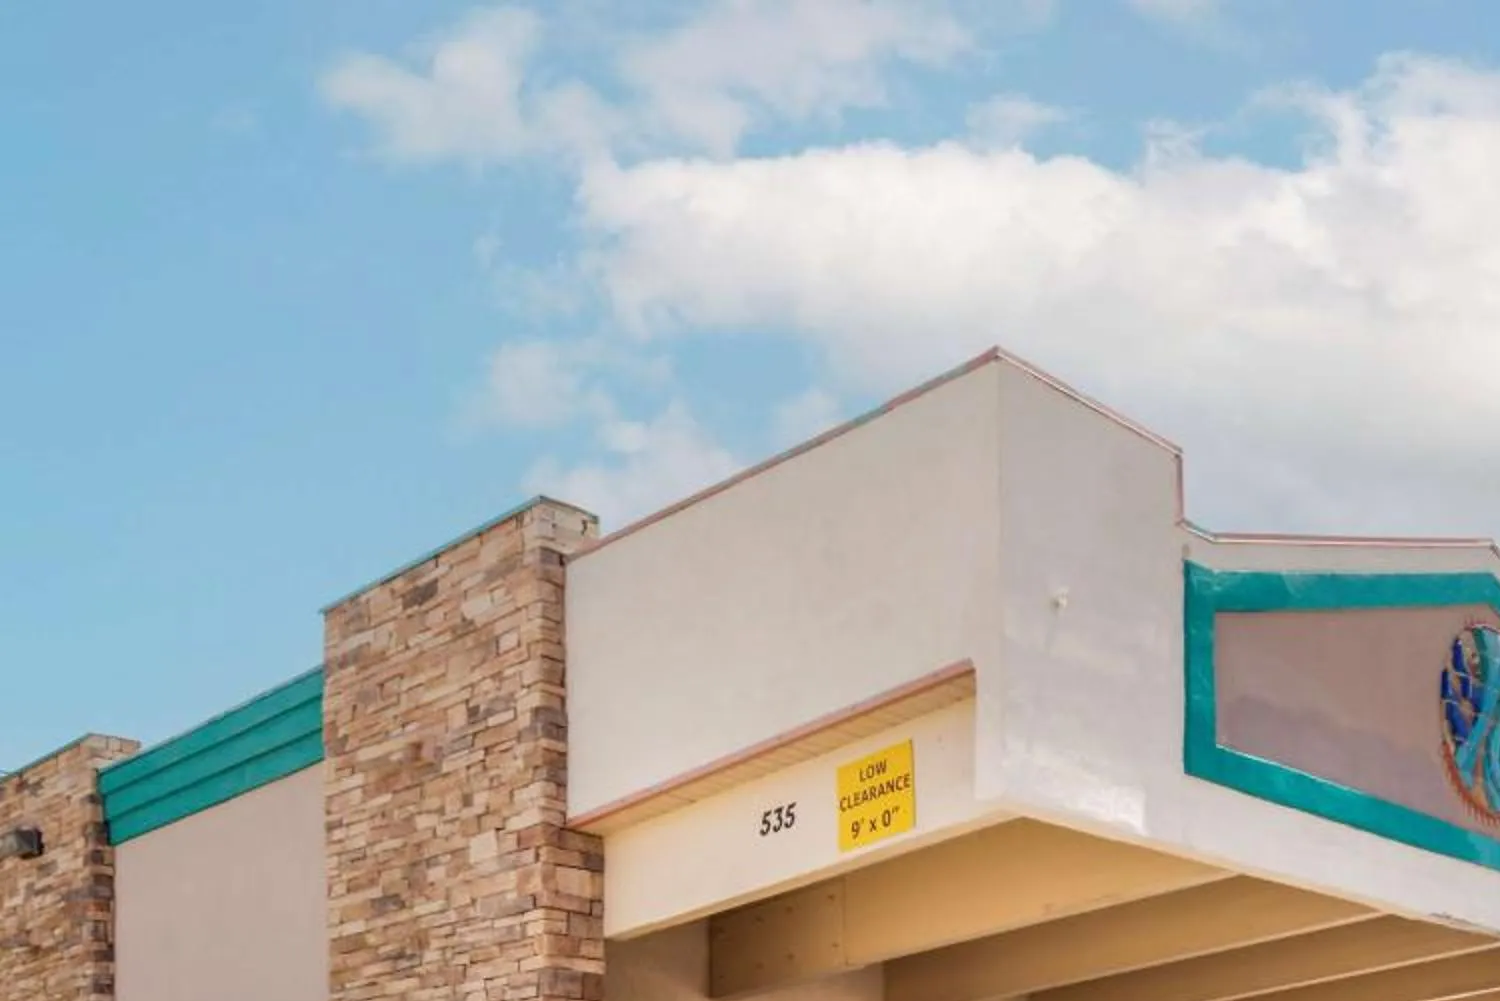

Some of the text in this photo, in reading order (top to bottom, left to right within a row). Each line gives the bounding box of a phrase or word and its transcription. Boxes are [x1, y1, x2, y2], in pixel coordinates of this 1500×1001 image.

[859, 759, 887, 782] LOW
[839, 773, 911, 812] CLEARANCE
[759, 802, 797, 836] 535
[869, 818, 877, 833] x
